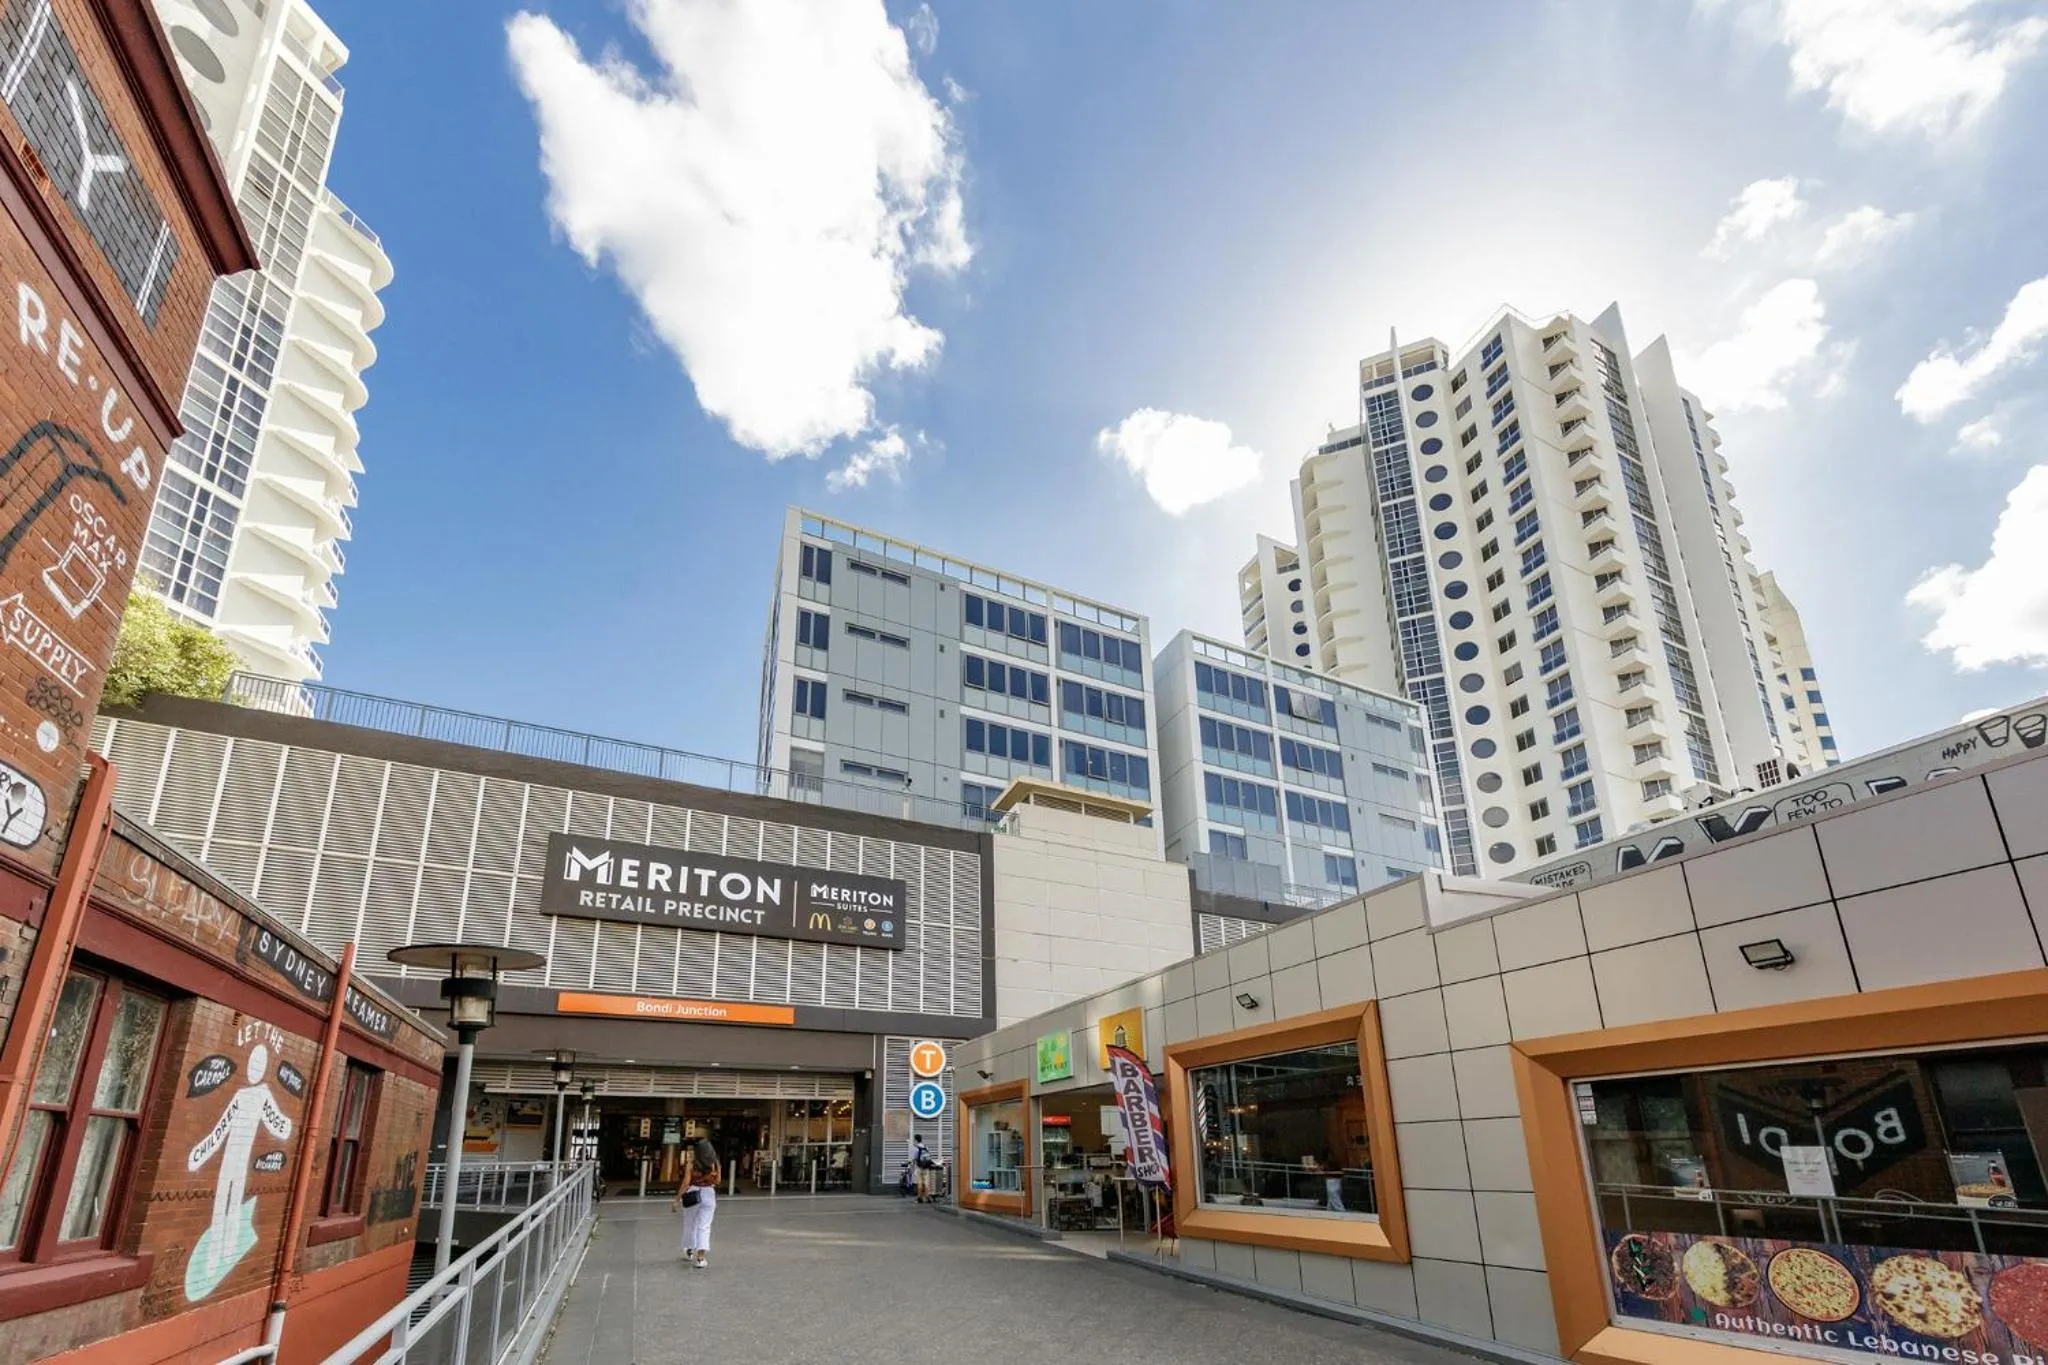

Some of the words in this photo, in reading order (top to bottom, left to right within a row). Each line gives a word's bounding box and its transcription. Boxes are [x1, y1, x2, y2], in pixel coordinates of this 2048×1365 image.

[70, 494, 128, 569] OSCAR
[73, 521, 112, 575] MAX
[9, 608, 87, 684] SUPPLY
[1942, 736, 1978, 760] HAPPY
[1788, 804, 1816, 821] FEW
[1820, 798, 1843, 810] TO
[1792, 790, 1827, 806] TOO
[563, 846, 781, 906] MERITON
[1535, 864, 1586, 886] MISTAKES
[579, 890, 655, 914] RETAIL
[663, 899, 766, 926] PRECINCT
[810, 883, 894, 908] MERITON
[836, 902, 869, 913] SUITES
[258, 930, 327, 998] SYDNEY
[636, 1001, 673, 1015] Bondi
[676, 1004, 727, 1018] Junction
[237, 1021, 262, 1047] LET
[920, 1049, 937, 1070] T
[920, 1089, 937, 1111] B
[1120, 1061, 1157, 1164] BARBER
[193, 1099, 240, 1162] CHILDREN
[1137, 1162, 1161, 1178] SHOP
[1715, 1311, 1840, 1344] Authentic
[1847, 1330, 2000, 1365] Lebanese
